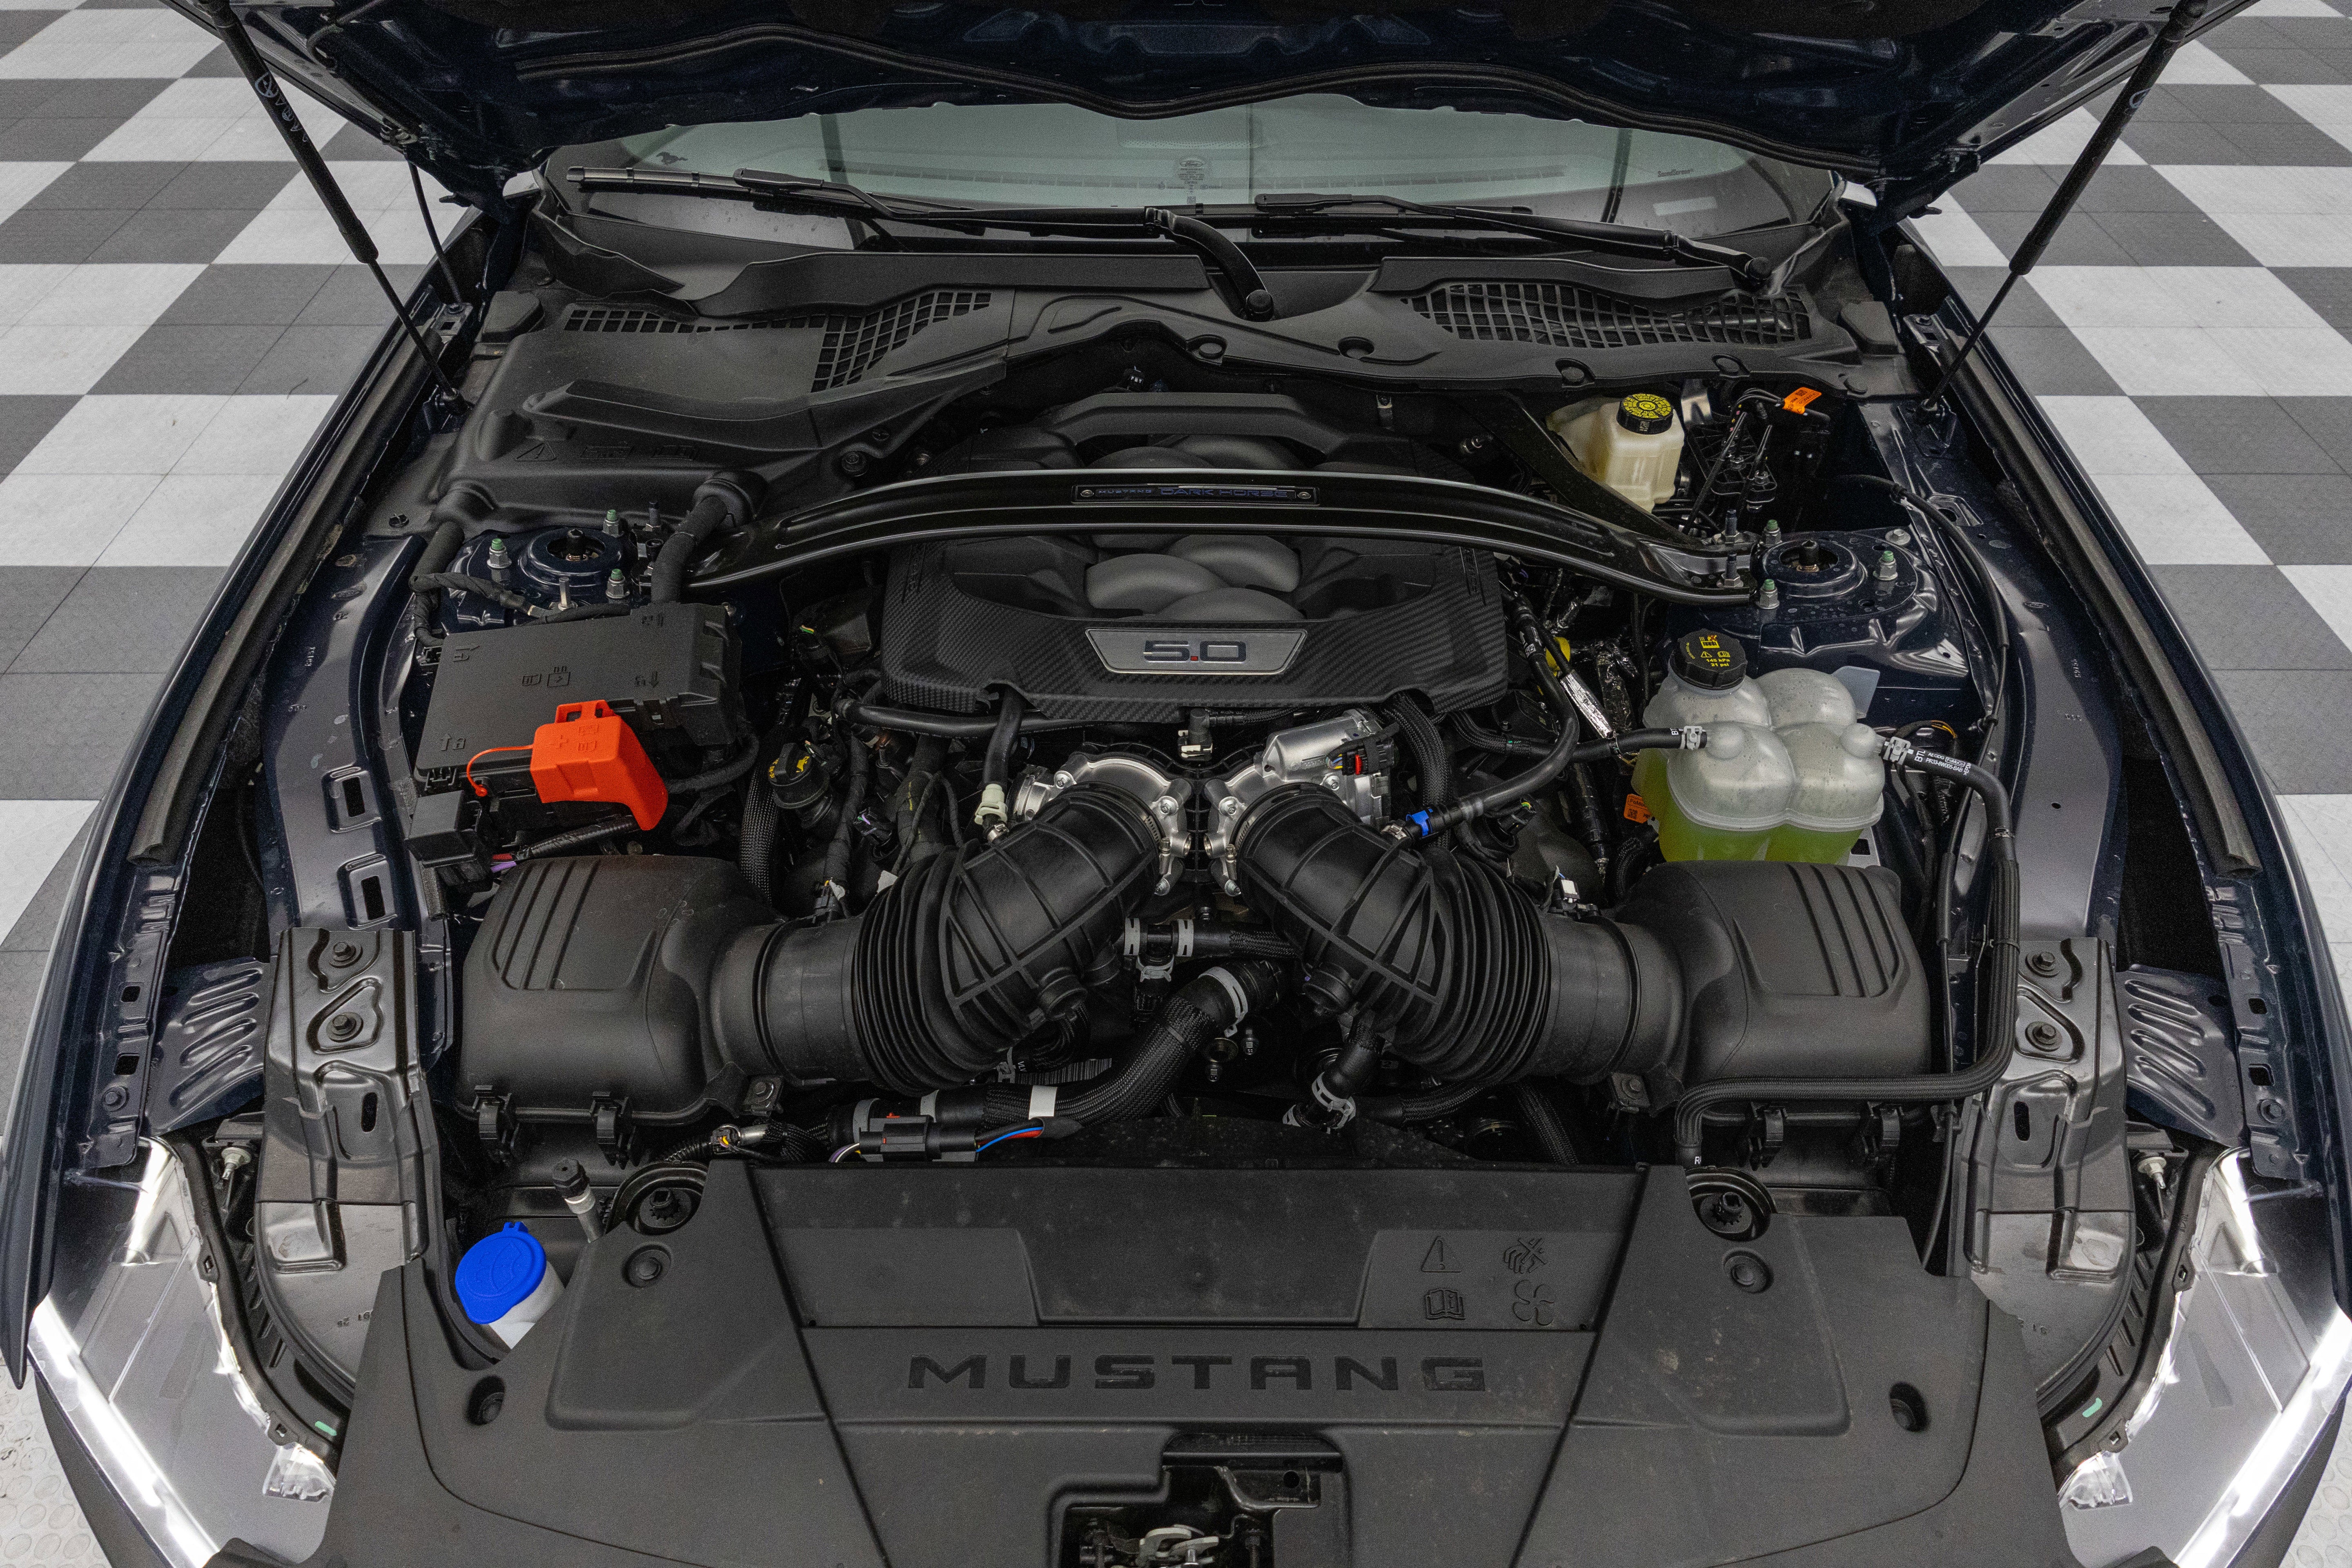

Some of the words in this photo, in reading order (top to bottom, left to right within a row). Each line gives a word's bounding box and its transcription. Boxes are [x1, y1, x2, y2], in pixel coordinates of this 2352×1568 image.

[1219, 489, 1288, 498] HORSE
[1143, 640, 1247, 662] 5.0
[1914, 750, 1926, 762] BTL
[1946, 757, 1964, 766] FoMoCo
[909, 1354, 1486, 1391] MUSTANG
